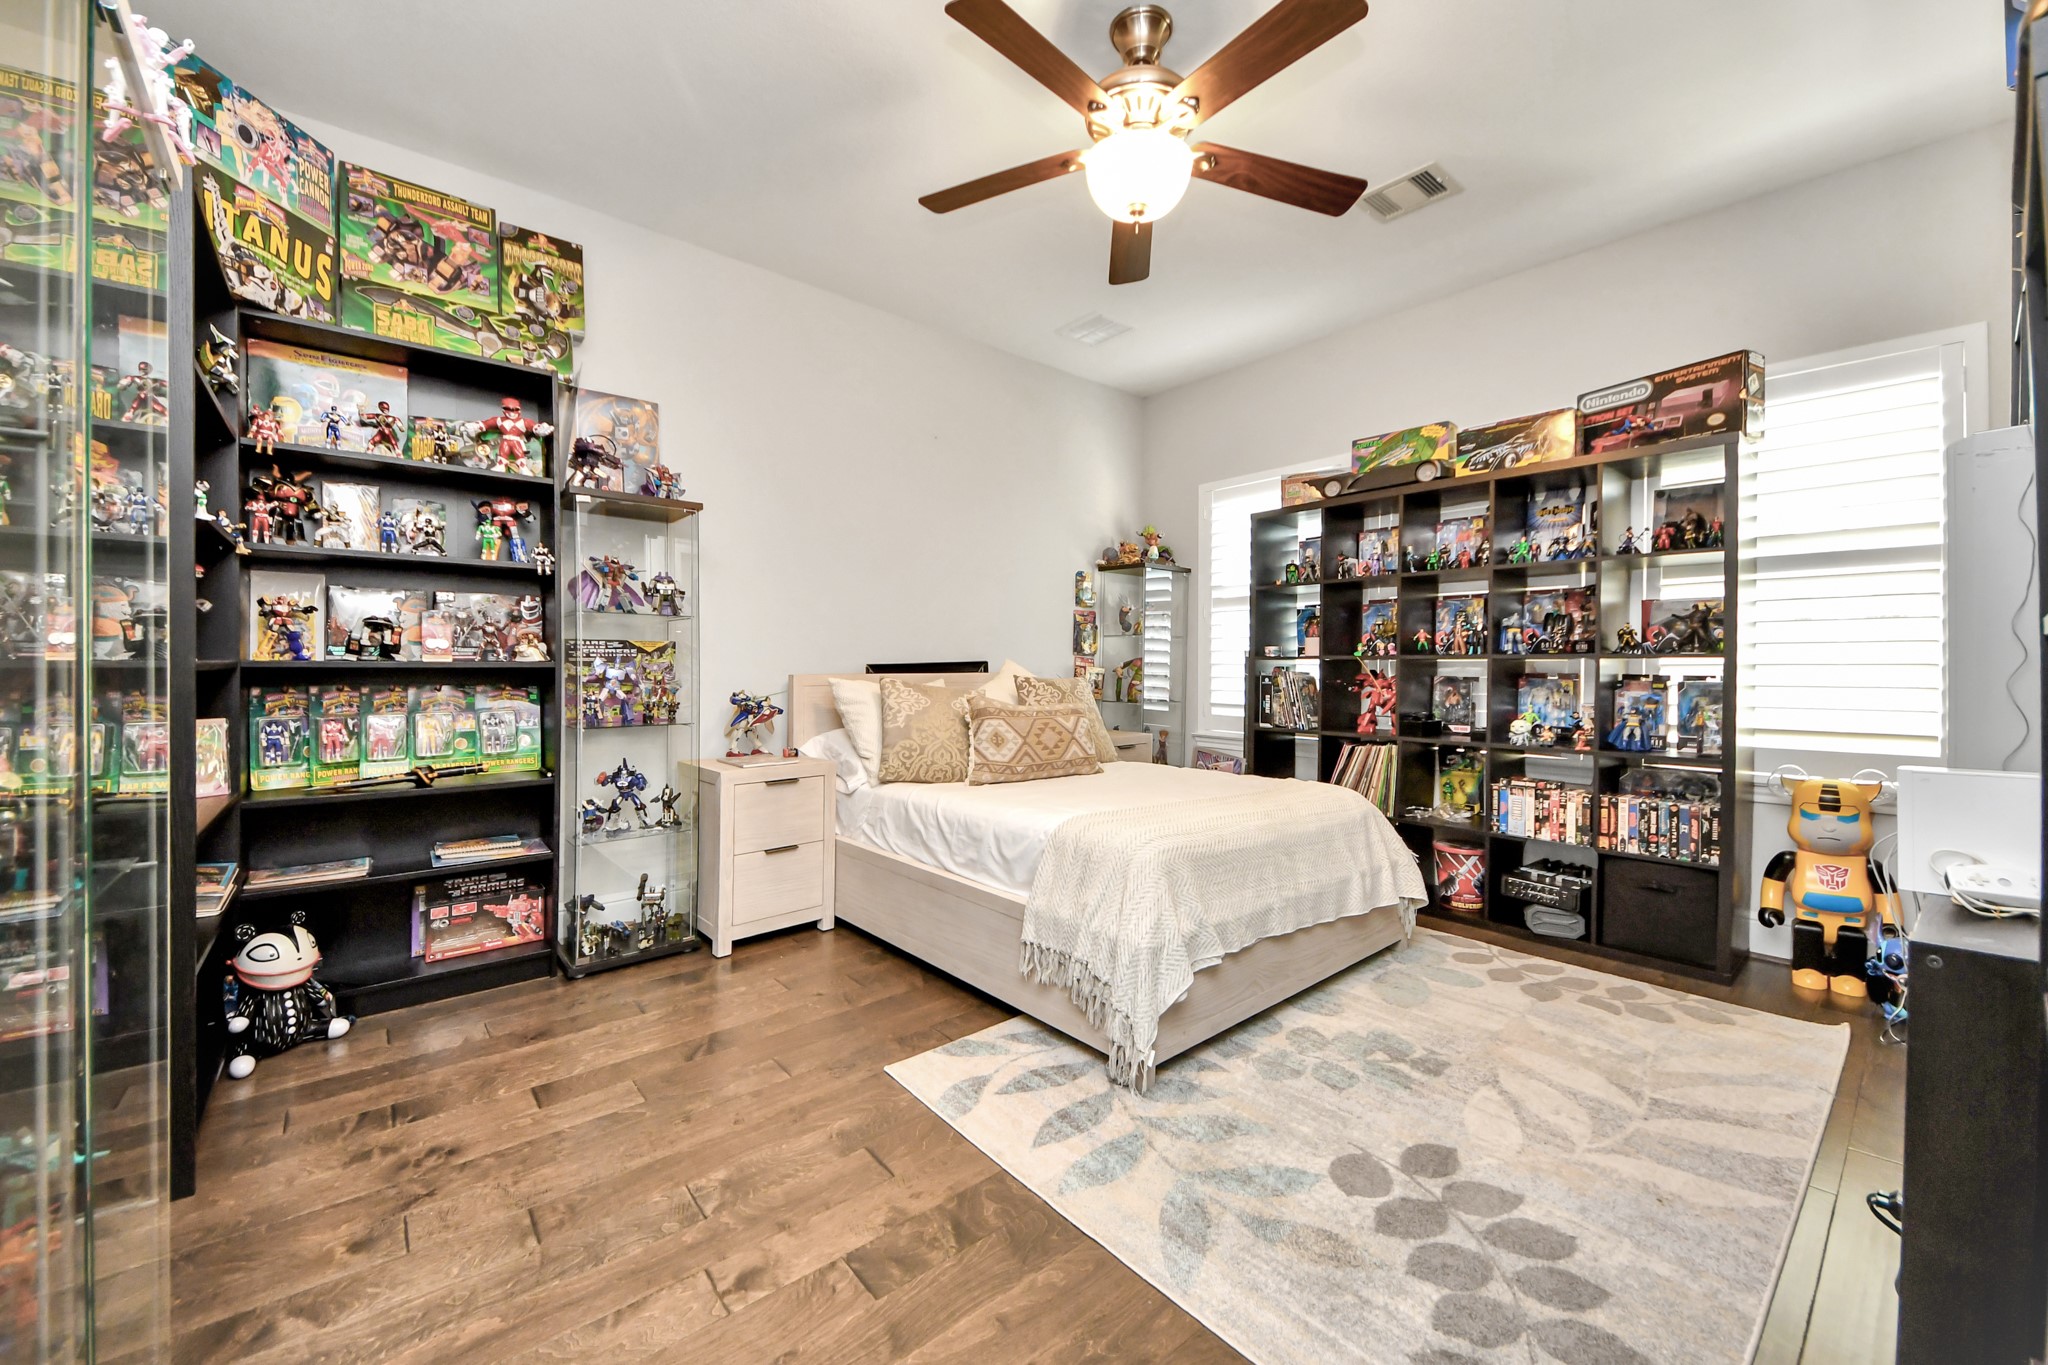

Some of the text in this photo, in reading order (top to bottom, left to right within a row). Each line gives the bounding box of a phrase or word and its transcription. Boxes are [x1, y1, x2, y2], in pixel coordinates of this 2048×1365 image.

[298, 156, 330, 194] POWER
[299, 178, 330, 211] CANNON
[393, 183, 441, 208] THUNDERZORD
[442, 199, 469, 217] ASSAULT
[471, 208, 488, 224] TEAM
[1654, 354, 1743, 383] ENTERTAINMENT
[1675, 367, 1720, 384] SYSTEM
[1585, 386, 1646, 409] Nintendo
[506, 757, 535, 765] RANGERS
[290, 771, 310, 779] RANG
[317, 768, 343, 778] POWER
[444, 874, 488, 889] TRANS
[461, 878, 525, 895] FORMERS
